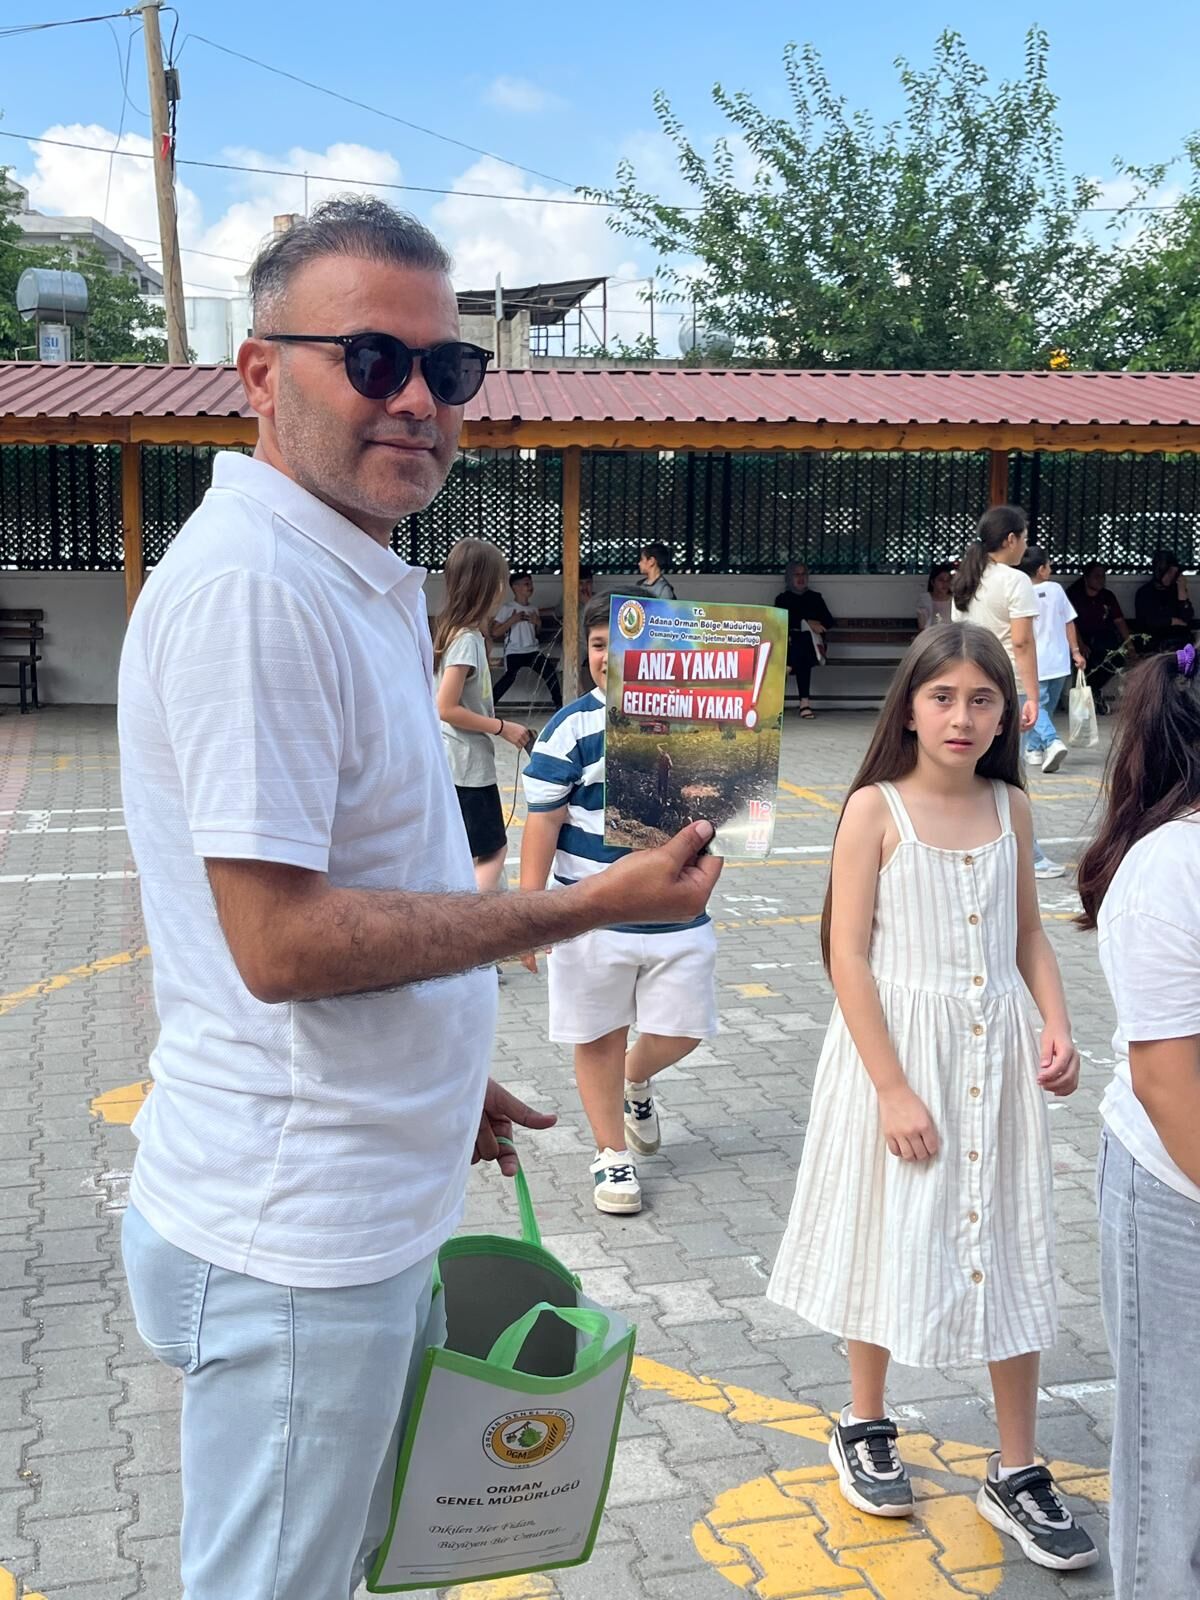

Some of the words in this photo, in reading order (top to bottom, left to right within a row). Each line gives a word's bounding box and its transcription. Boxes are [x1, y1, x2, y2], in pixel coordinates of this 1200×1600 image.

[693, 608, 705, 616] T.C.
[649, 616, 673, 626] Adana
[674, 618, 699, 628] Orman
[700, 620, 721, 631] Bölge
[723, 622, 761, 632] Müdürlüğü
[649, 630, 680, 640] Osmaniye
[681, 632, 701, 641] Orman
[637, 651, 677, 681] ANIZ
[680, 650, 739, 681] YAKAN
[624, 690, 693, 719] GELECEĞİNİ
[697, 696, 744, 720] YAKAR
[436, 1496, 484, 1506] GENEL
[487, 1479, 581, 1506] MÜDÜRLÜĞÜ
[486, 1480, 543, 1494] ORMAN
